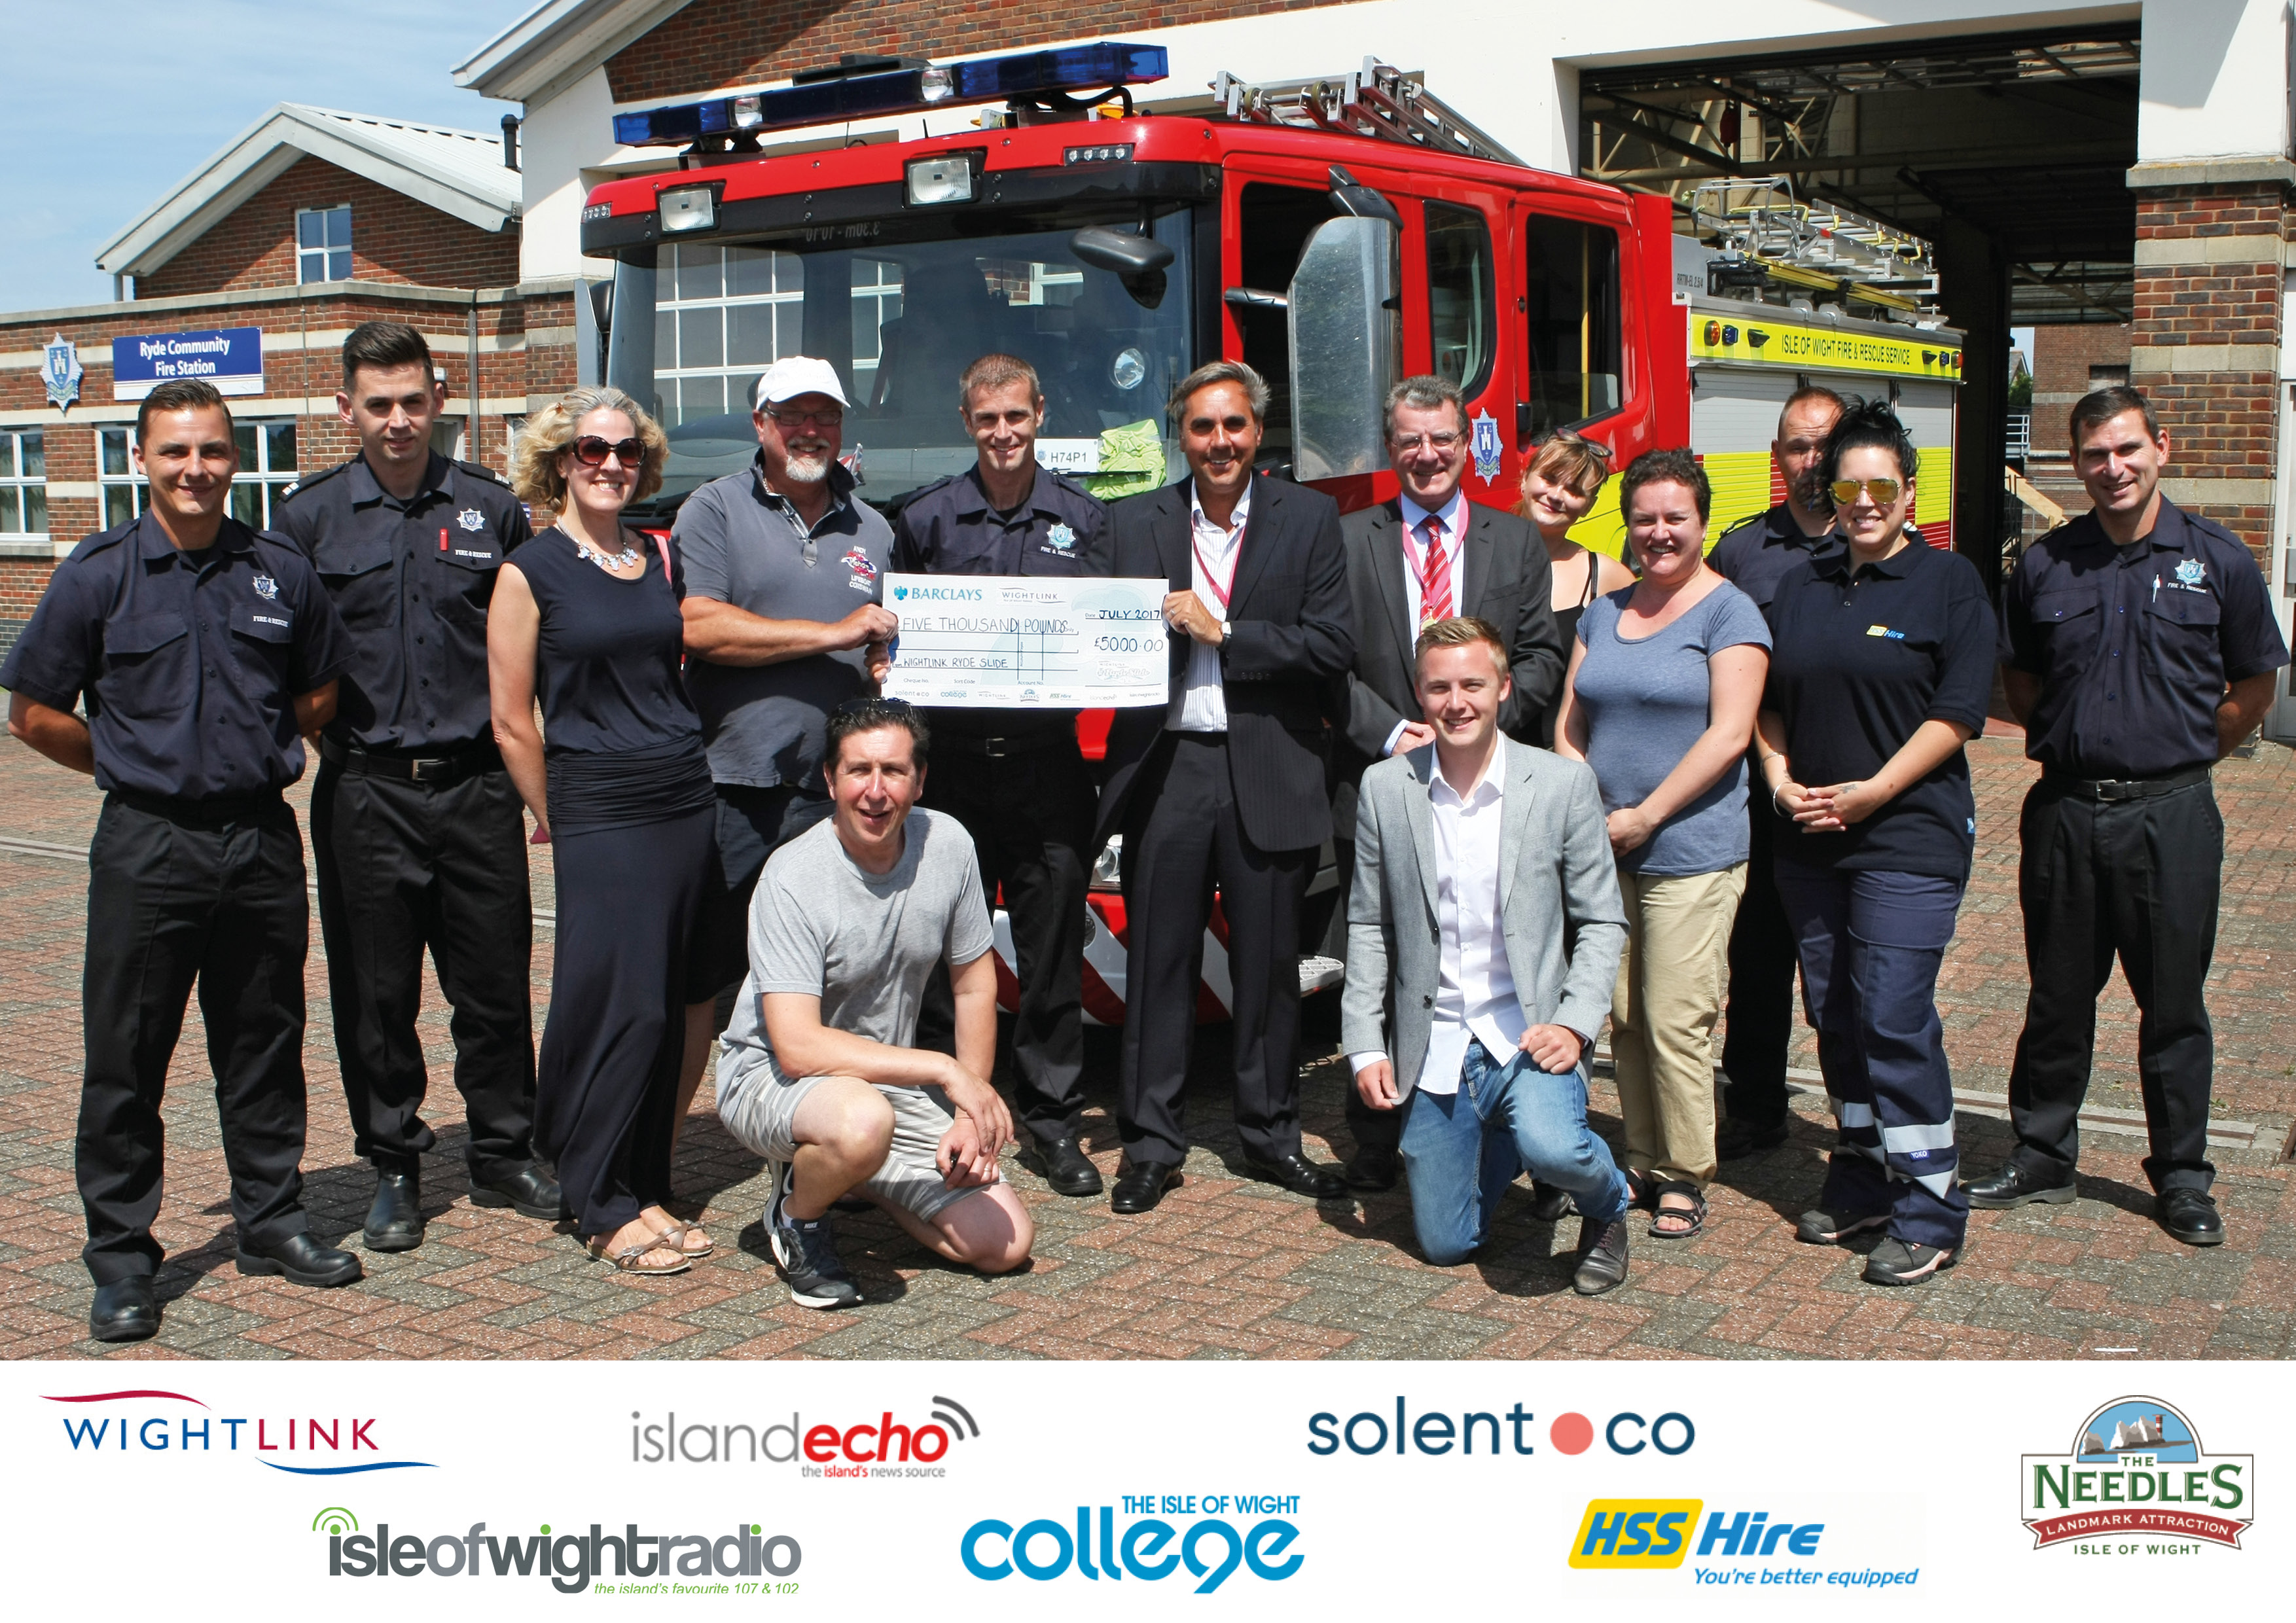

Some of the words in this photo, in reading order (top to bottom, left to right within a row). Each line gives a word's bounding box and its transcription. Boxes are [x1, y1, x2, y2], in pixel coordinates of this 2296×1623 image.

[140, 341, 166, 359] Ryde
[168, 336, 230, 355] Community
[1782, 334, 1799, 354] ISLE
[1801, 336, 1810, 355] OF
[1812, 338, 1836, 358] WIGHT
[1838, 341, 1852, 359] FIRE
[1854, 343, 1857, 359] &
[1860, 344, 1884, 363] RESCUE
[1886, 347, 1910, 365] SERVICE
[156, 361, 175, 376] Fire
[177, 359, 215, 375] Station
[1050, 452, 1086, 463] H74P1
[911, 588, 982, 601] BARCLAYS
[1002, 592, 1058, 601] WIGHTLINK
[1099, 610, 1132, 619] JULY
[1135, 609, 1160, 619] 2017
[903, 617, 932, 631] FIVE
[939, 617, 1018, 632] THOUSAND
[1024, 618, 1068, 633] POUNDS
[1884, 630, 1905, 639] Hire
[904, 658, 948, 668] WIGHTLINK
[952, 657, 976, 668] RYDE
[979, 658, 1008, 668] SLIDE
[1910, 1150, 1928, 1158] YOKO
